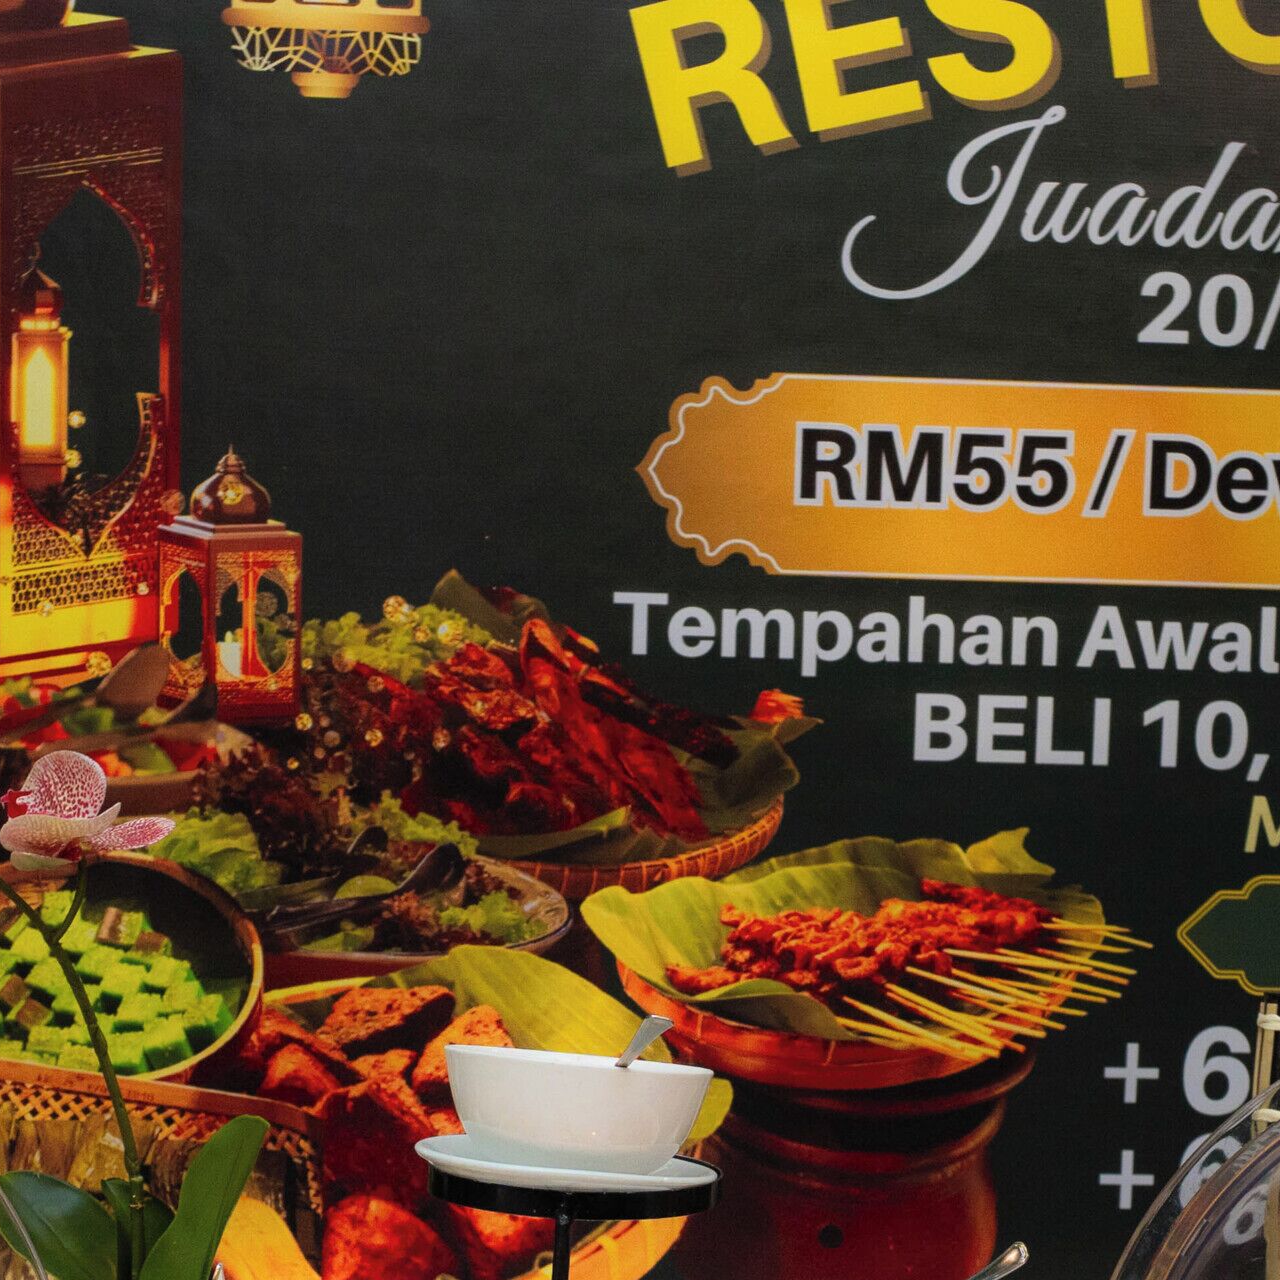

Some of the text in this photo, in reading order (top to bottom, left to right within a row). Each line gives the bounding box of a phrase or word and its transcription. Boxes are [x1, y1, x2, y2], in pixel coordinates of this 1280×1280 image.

[796, 424, 1072, 510] RM55
[613, 592, 1059, 677] Tempahan
[1077, 606, 1278, 674] Awal
[912, 693, 1112, 767] BELI
[1142, 700, 1271, 783] 10,
